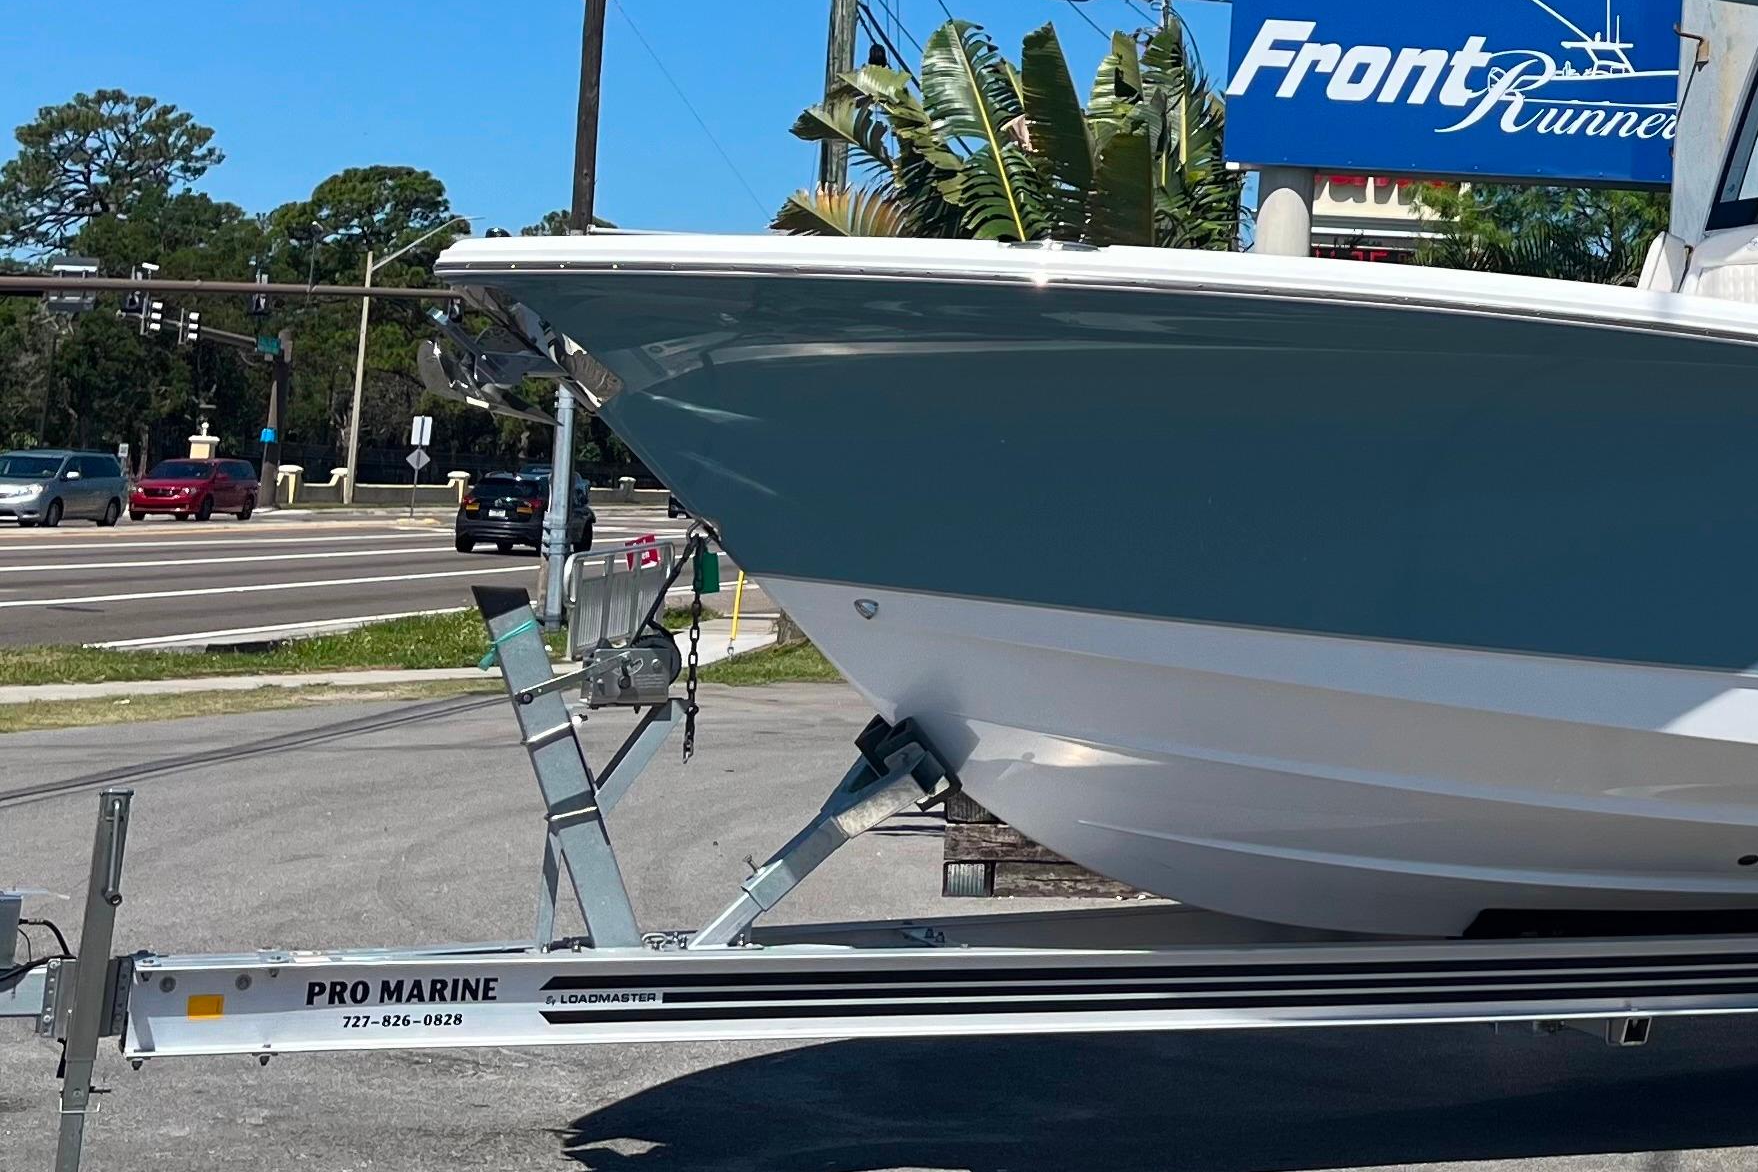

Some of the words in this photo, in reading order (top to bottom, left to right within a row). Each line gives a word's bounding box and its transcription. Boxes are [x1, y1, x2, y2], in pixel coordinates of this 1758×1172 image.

[1224, 19, 1491, 107] Front
[1434, 50, 1677, 141] Runner
[306, 980, 370, 1006] PRO
[379, 977, 499, 1004] MARINE
[560, 992, 657, 1004] LOADMASTER
[343, 1013, 463, 1029] 727-826-0828
